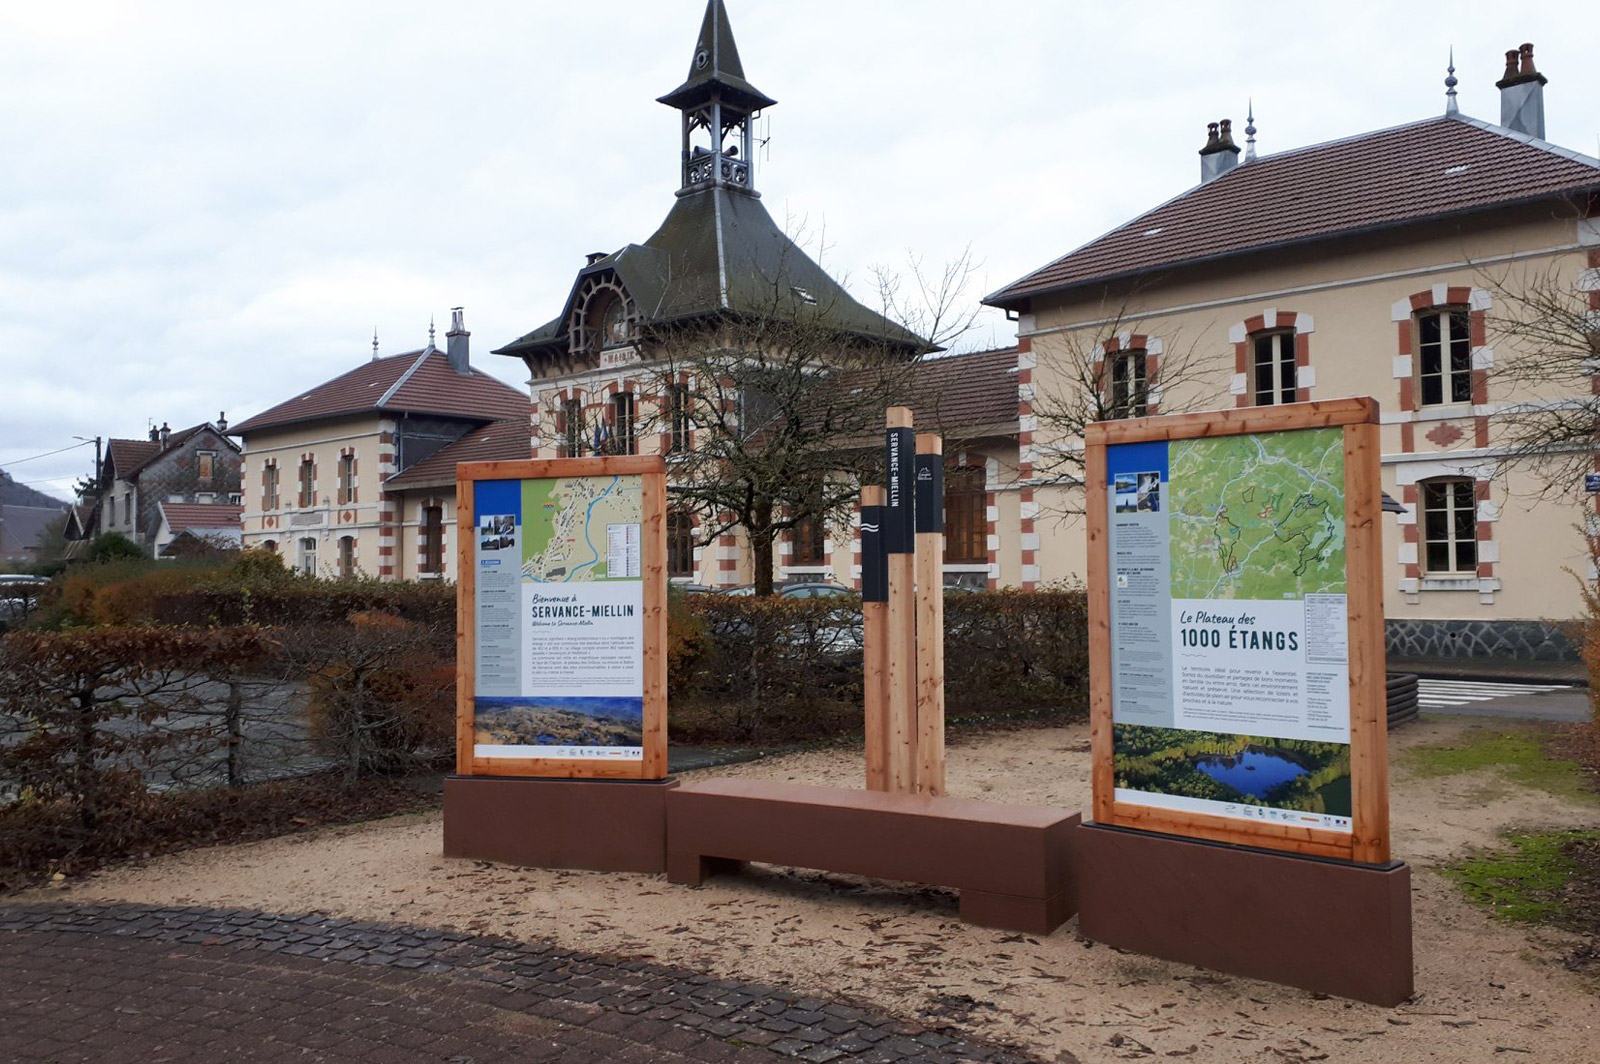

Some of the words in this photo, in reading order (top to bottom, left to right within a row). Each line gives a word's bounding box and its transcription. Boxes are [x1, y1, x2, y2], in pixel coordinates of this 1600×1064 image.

[608, 350, 635, 364] MAIRIE
[890, 432, 899, 507] SERVANCE-MIELLIN
[532, 594, 569, 604] Bienvenue
[571, 594, 577, 602] à
[532, 604, 634, 618] SERVANCE-MIELLIN
[1180, 610, 1192, 624] Le
[1196, 610, 1234, 624] Plateau
[1238, 613, 1256, 625] des
[1181, 629, 1220, 648] 1000
[1229, 625, 1298, 651] ÉTANGS
